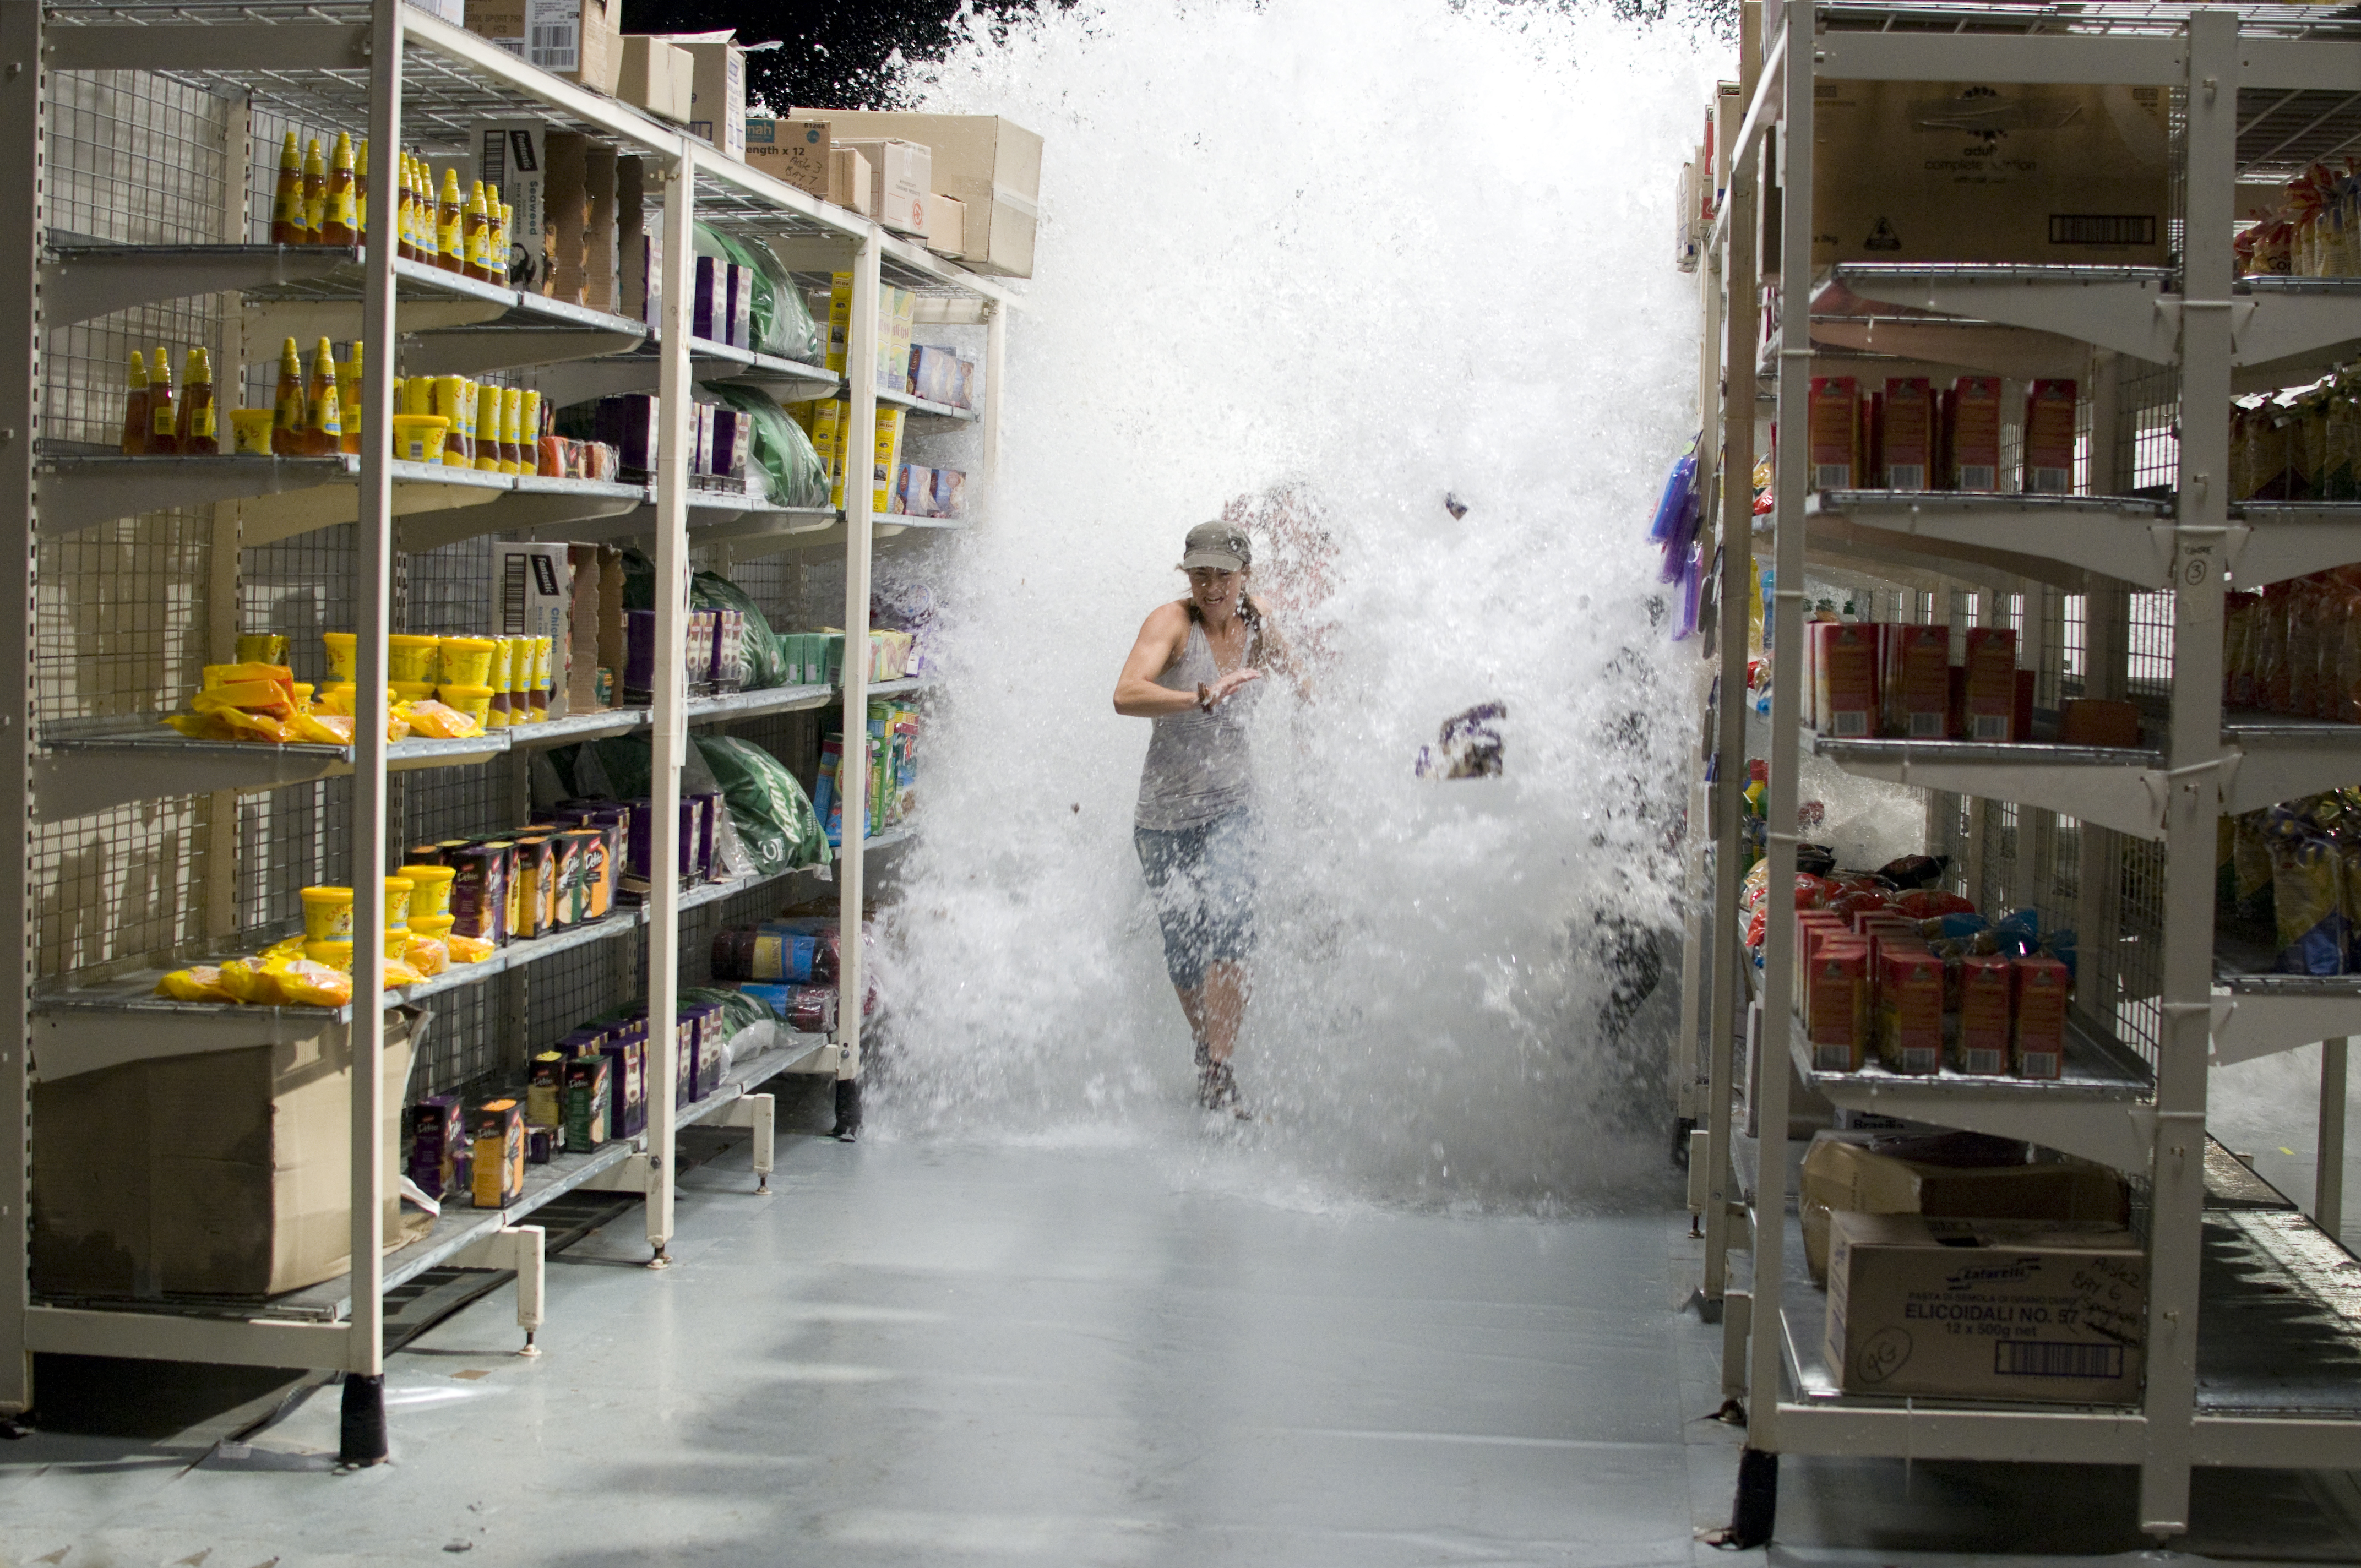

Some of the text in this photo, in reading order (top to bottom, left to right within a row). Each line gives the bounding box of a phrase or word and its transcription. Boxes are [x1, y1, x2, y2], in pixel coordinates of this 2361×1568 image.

[516, 132, 532, 170] Fantastic
[793, 148, 805, 156] 12
[530, 181, 538, 235] Seaweed
[537, 557, 554, 594] Fantastic
[551, 607, 561, 654] Chicken
[1905, 1304, 2013, 1321] ELICOIDALI
[2019, 1308, 2052, 1323] NO.
[1946, 1322, 2037, 1338] 12 x 500g net
